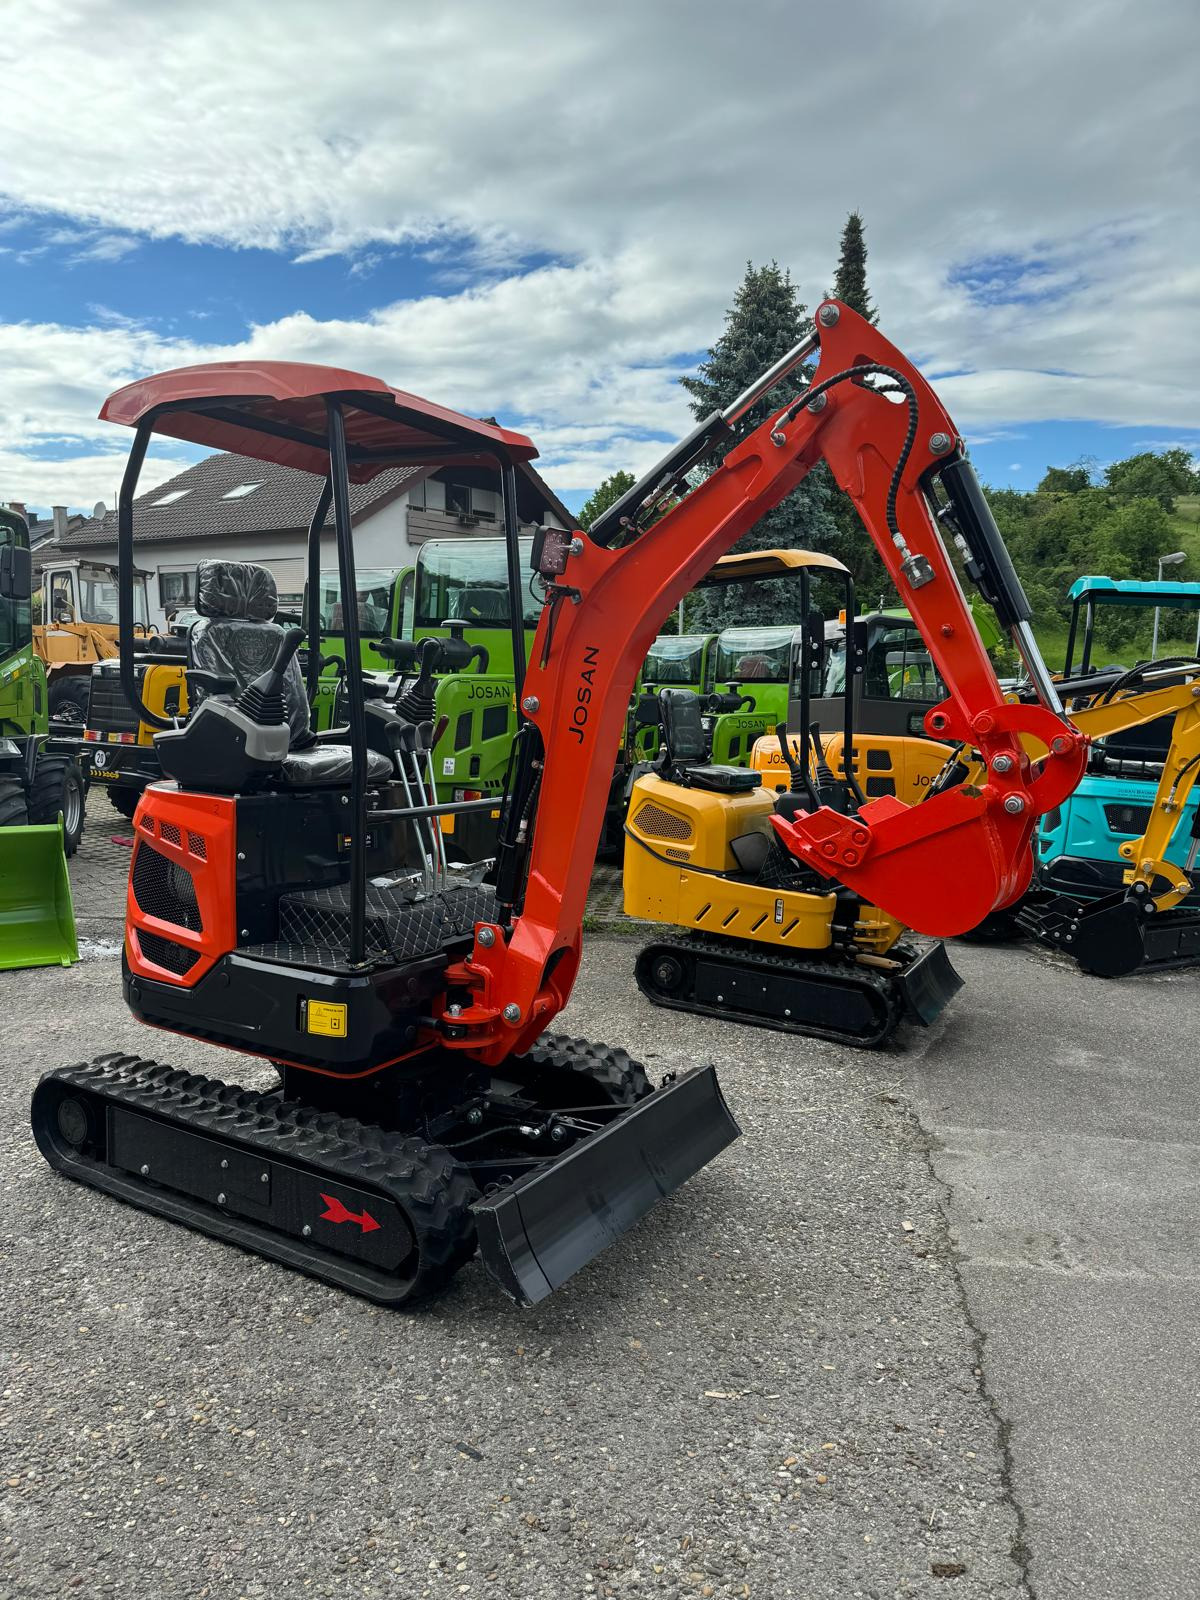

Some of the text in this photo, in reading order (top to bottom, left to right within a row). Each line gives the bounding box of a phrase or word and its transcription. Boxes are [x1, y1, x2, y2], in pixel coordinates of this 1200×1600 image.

[468, 684, 510, 699] JOSAN
[568, 646, 600, 744] JOSAN
[736, 720, 765, 729] JOSAN
[96, 753, 104, 764] 20
